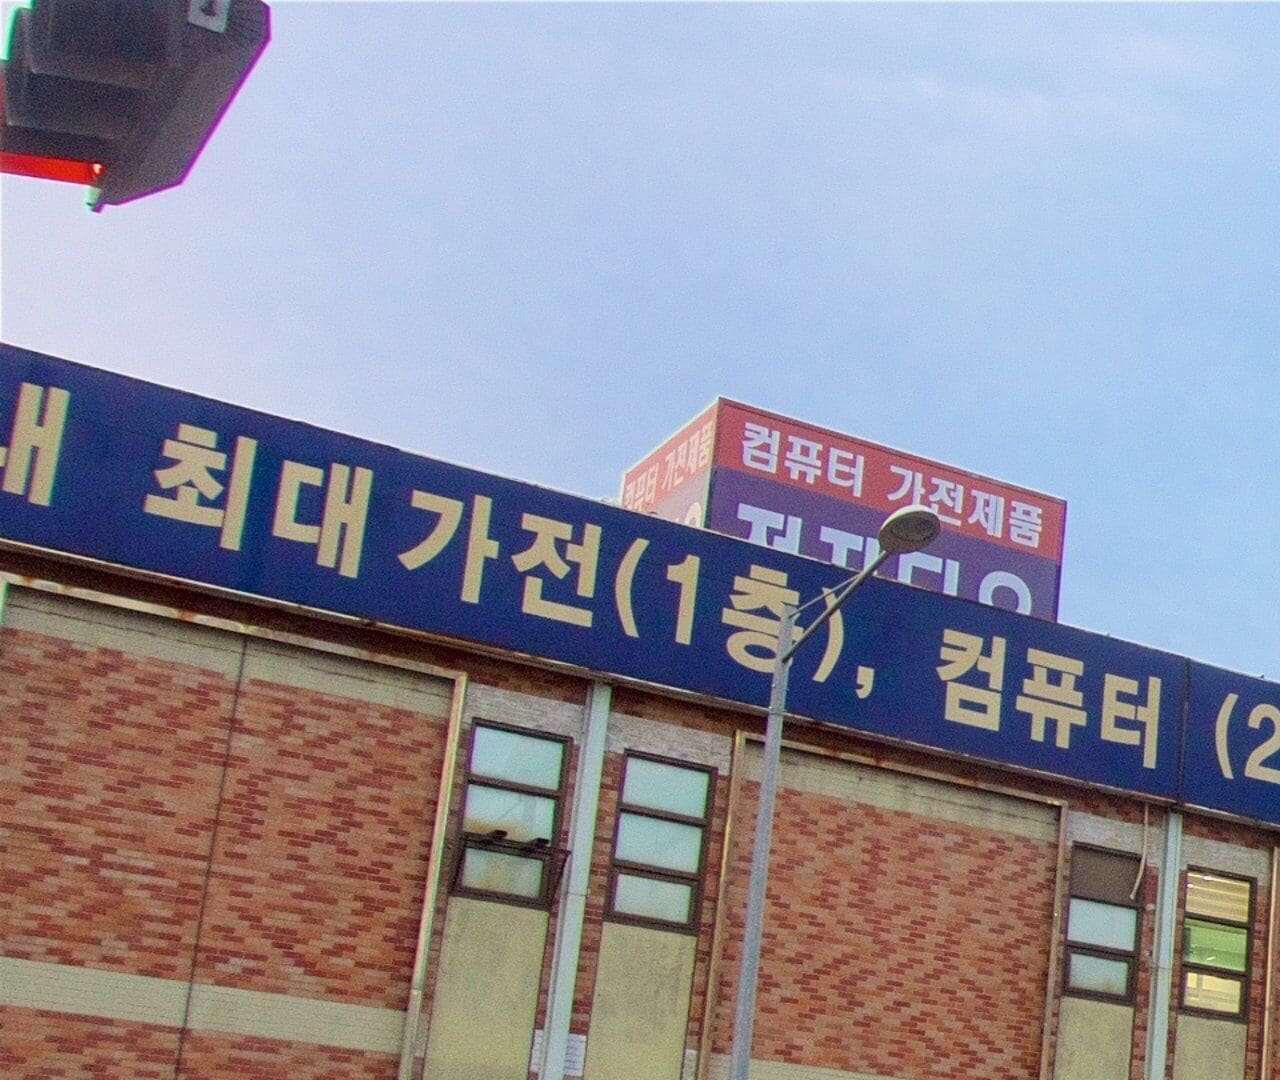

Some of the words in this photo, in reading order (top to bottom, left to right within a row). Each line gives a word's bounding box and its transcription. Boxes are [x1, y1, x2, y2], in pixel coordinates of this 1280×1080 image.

[661, 420, 716, 492] 가전제품
[738, 420, 866, 498] 컴퓨터
[886, 464, 1044, 549] 가전제품
[143, 424, 374, 579] 최대
[935, 628, 1163, 770] 컴퓨터
